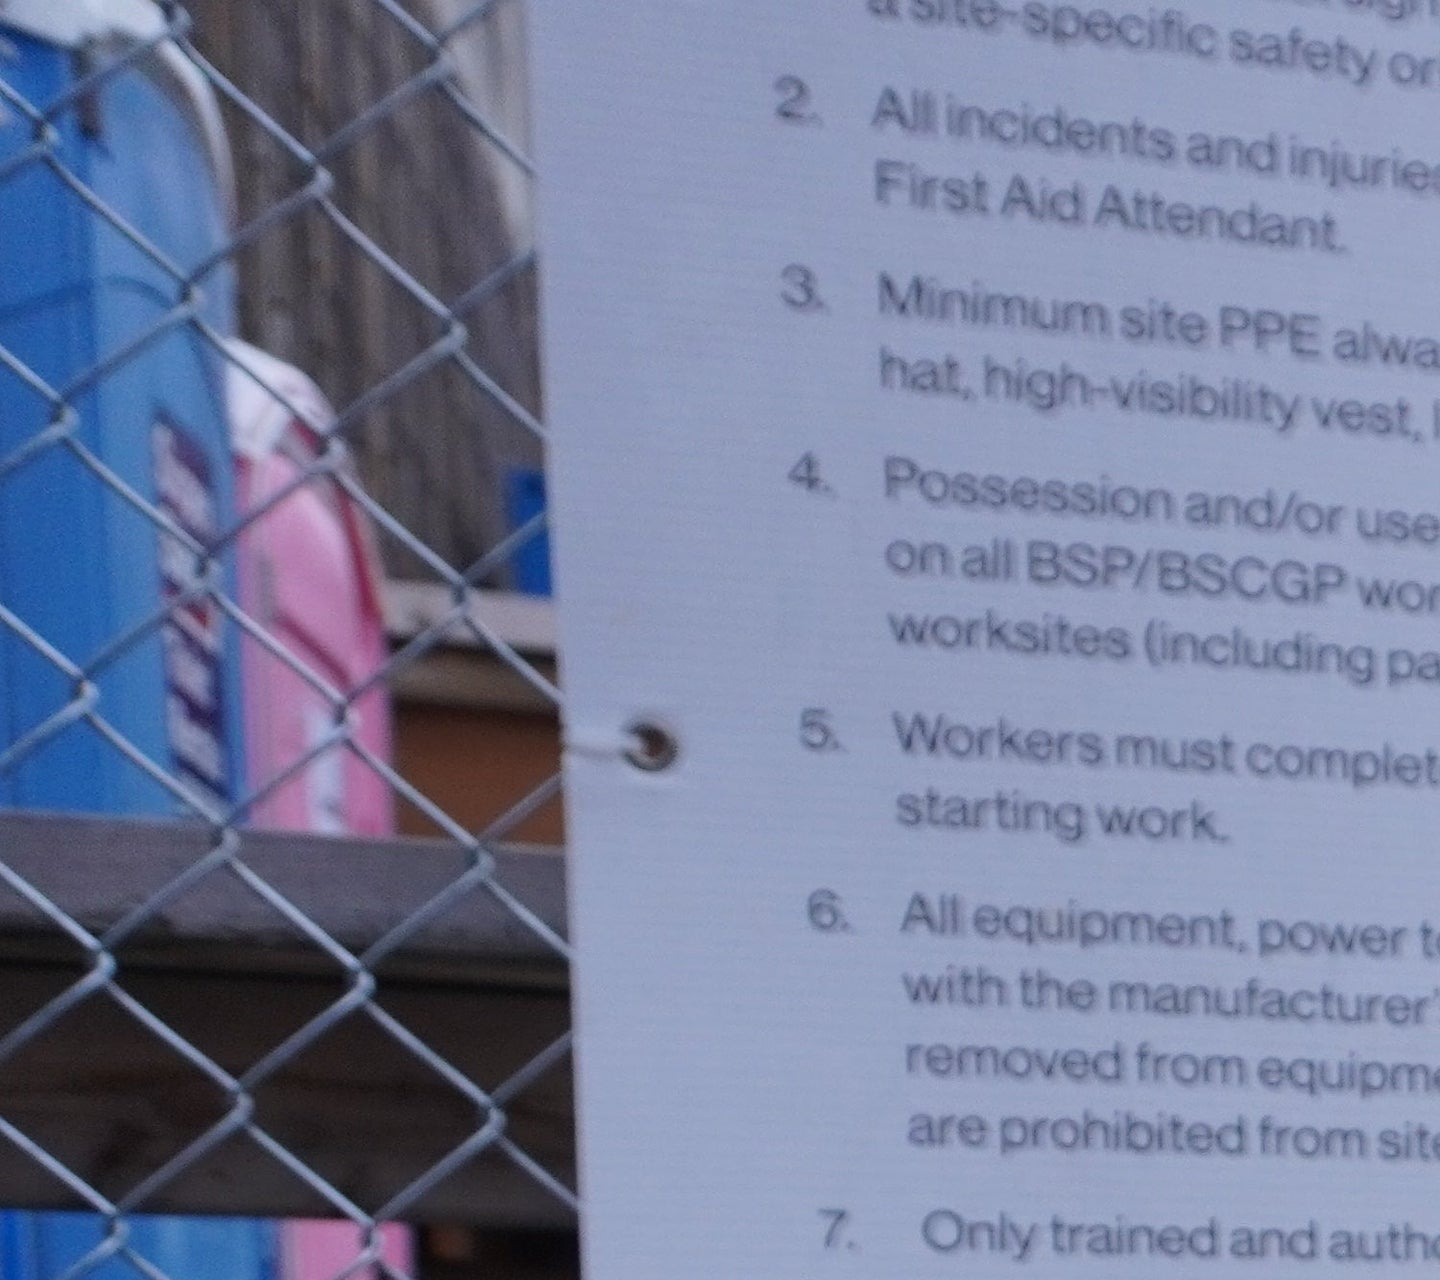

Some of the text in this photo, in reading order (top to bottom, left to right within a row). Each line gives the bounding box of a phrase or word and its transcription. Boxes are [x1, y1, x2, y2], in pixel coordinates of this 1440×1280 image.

[1229, 27, 1378, 88] safety
[774, 74, 820, 126] 2.
[871, 86, 937, 135] All
[946, 105, 1179, 165] incidents
[1185, 133, 1281, 177] and
[873, 158, 1349, 255] First Aid Attendant.
[781, 263, 828, 313] 3.
[877, 271, 1111, 335] Minimum
[1119, 303, 1210, 349] site
[1218, 304, 1321, 361] PPE
[982, 357, 1302, 435] high-visibility
[1311, 399, 1423, 444] vest,
[787, 451, 832, 496] 4.
[882, 455, 1176, 522] Possession
[1183, 491, 1344, 537] and/or
[883, 539, 953, 577] on
[959, 539, 1017, 582] all
[1025, 539, 1350, 606] BSP/BSCGP
[887, 610, 1135, 663] worksites
[1142, 620, 1379, 689] (including
[799, 706, 844, 755] 5.
[890, 712, 1107, 769] Workers
[1114, 734, 1236, 776] must
[895, 788, 1232, 847] starting work.
[805, 887, 852, 935] 6.
[899, 891, 964, 937] All
[970, 904, 1248, 955] equipment,
[1256, 918, 1408, 960] power
[901, 967, 1009, 1008] with
[1017, 969, 1100, 1015] the
[904, 1042, 1127, 1085] removed
[1134, 1041, 1249, 1088] from
[906, 1112, 991, 1150] are
[998, 1110, 1250, 1158] prohibited
[1256, 1115, 1370, 1160] from
[820, 1207, 858, 1253] 7.
[920, 1207, 1039, 1264] Only
[1048, 1216, 1221, 1261] trained
[1228, 1221, 1321, 1263] and
